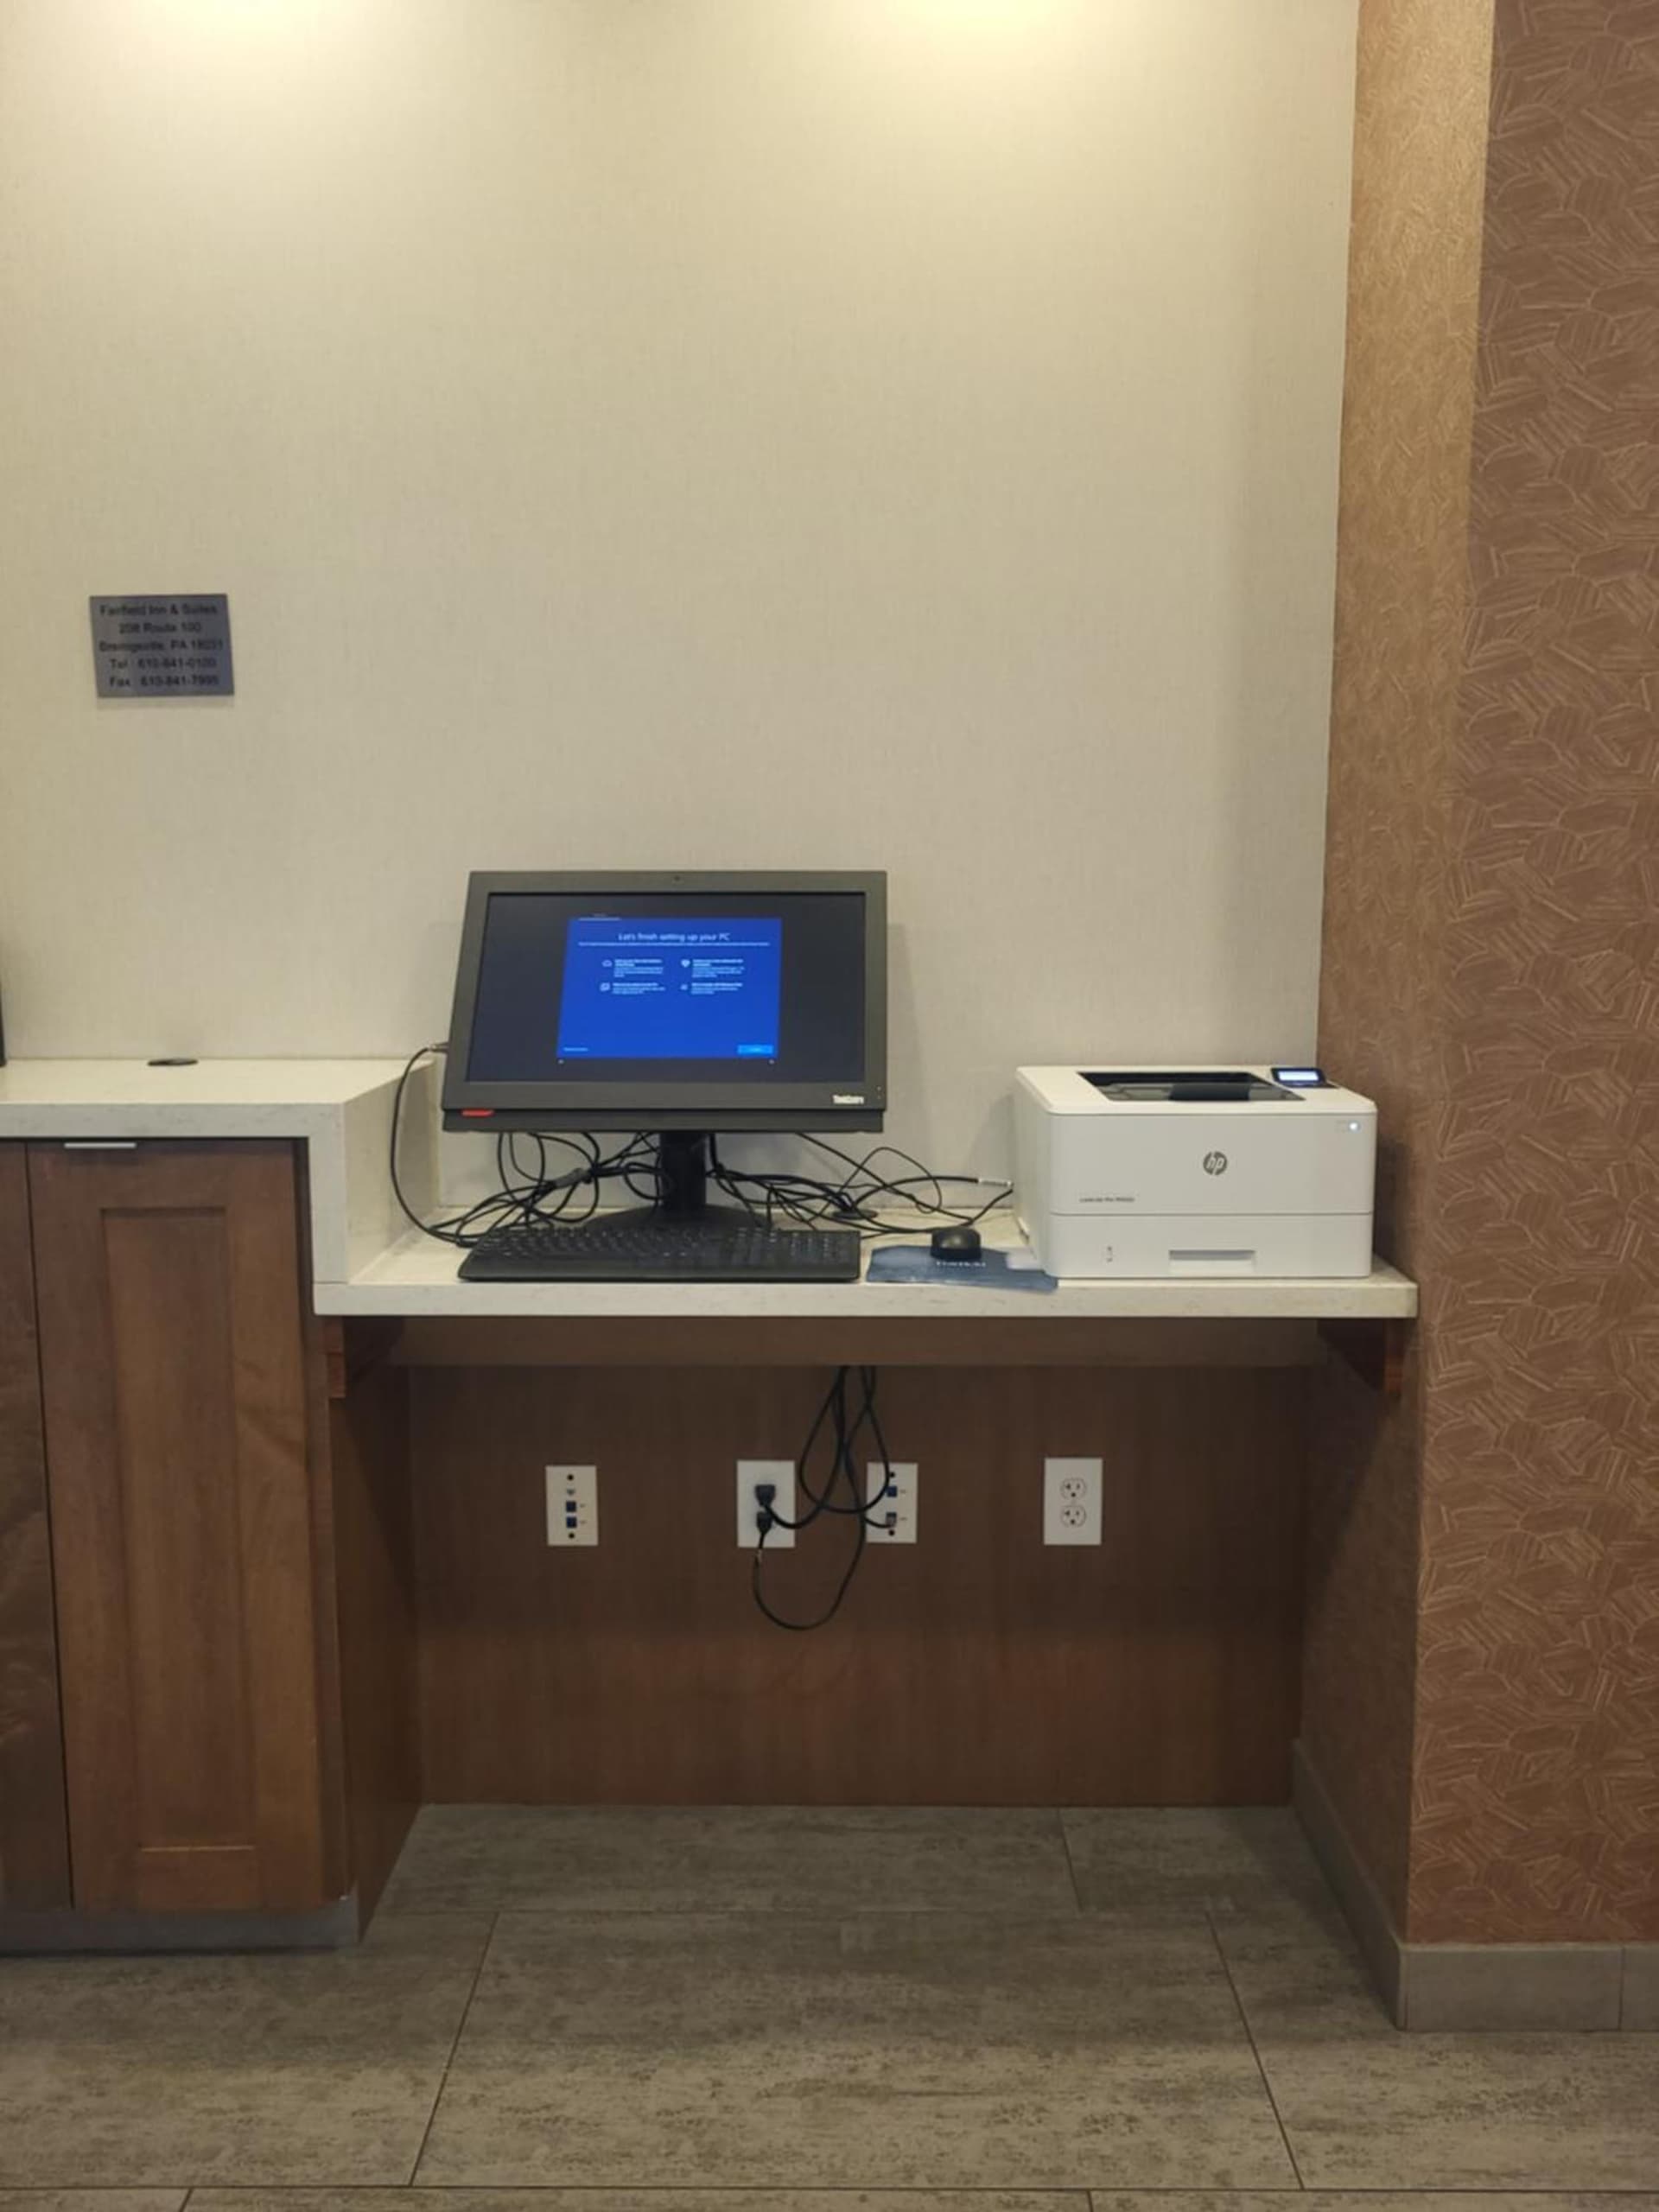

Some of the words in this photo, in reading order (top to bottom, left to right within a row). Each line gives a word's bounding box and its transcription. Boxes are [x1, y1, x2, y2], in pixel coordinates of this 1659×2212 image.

[148, 604, 167, 614] Inn
[170, 604, 179, 614] &
[618, 932, 637, 941] Let's
[638, 931, 657, 941] finish
[659, 932, 685, 943] setting
[687, 933, 699, 943] up
[700, 933, 717, 943] your
[719, 932, 730, 941] PC
[1202, 1151, 1228, 1176] hp
